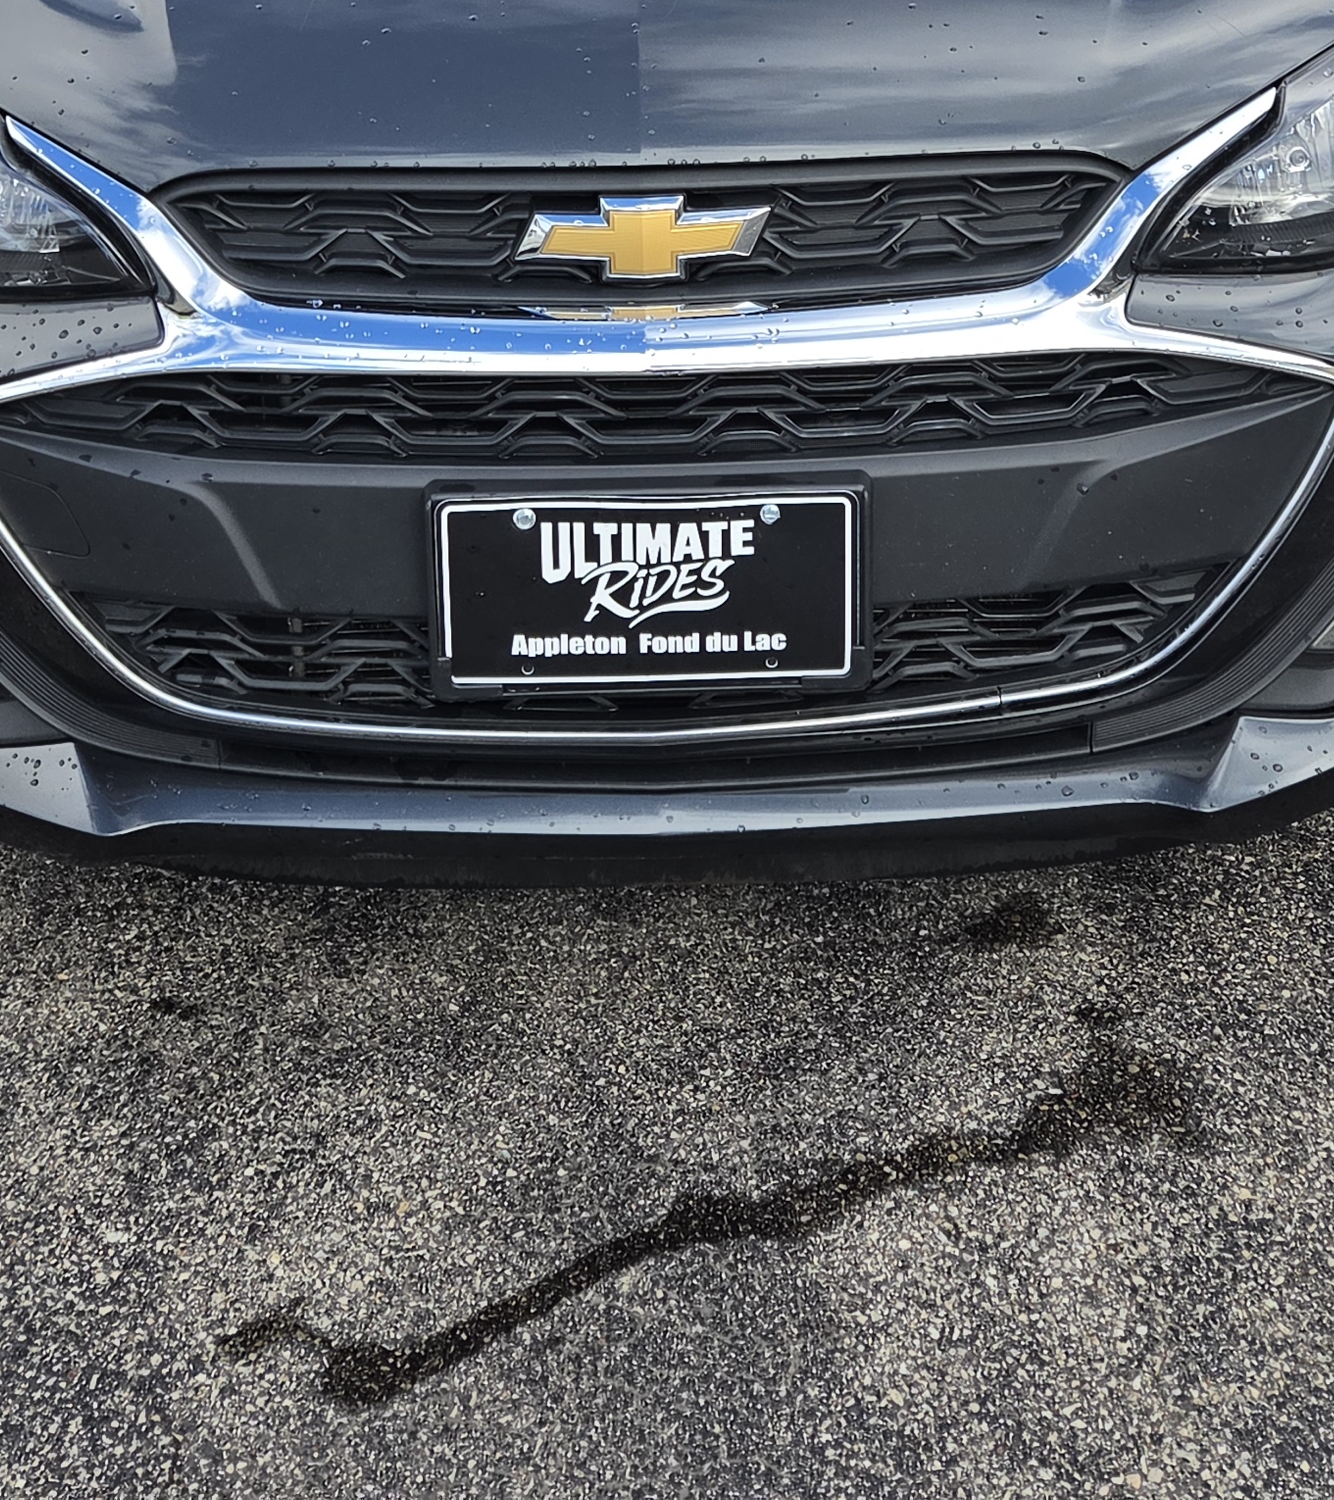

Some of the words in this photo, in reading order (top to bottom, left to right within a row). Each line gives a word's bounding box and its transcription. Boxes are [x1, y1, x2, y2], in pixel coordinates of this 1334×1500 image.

[540, 519, 755, 584] ULTIMATE
[511, 633, 627, 658] Appleton
[639, 631, 700, 655] Fond
[705, 631, 738, 653] du
[743, 631, 787, 652] Lac
